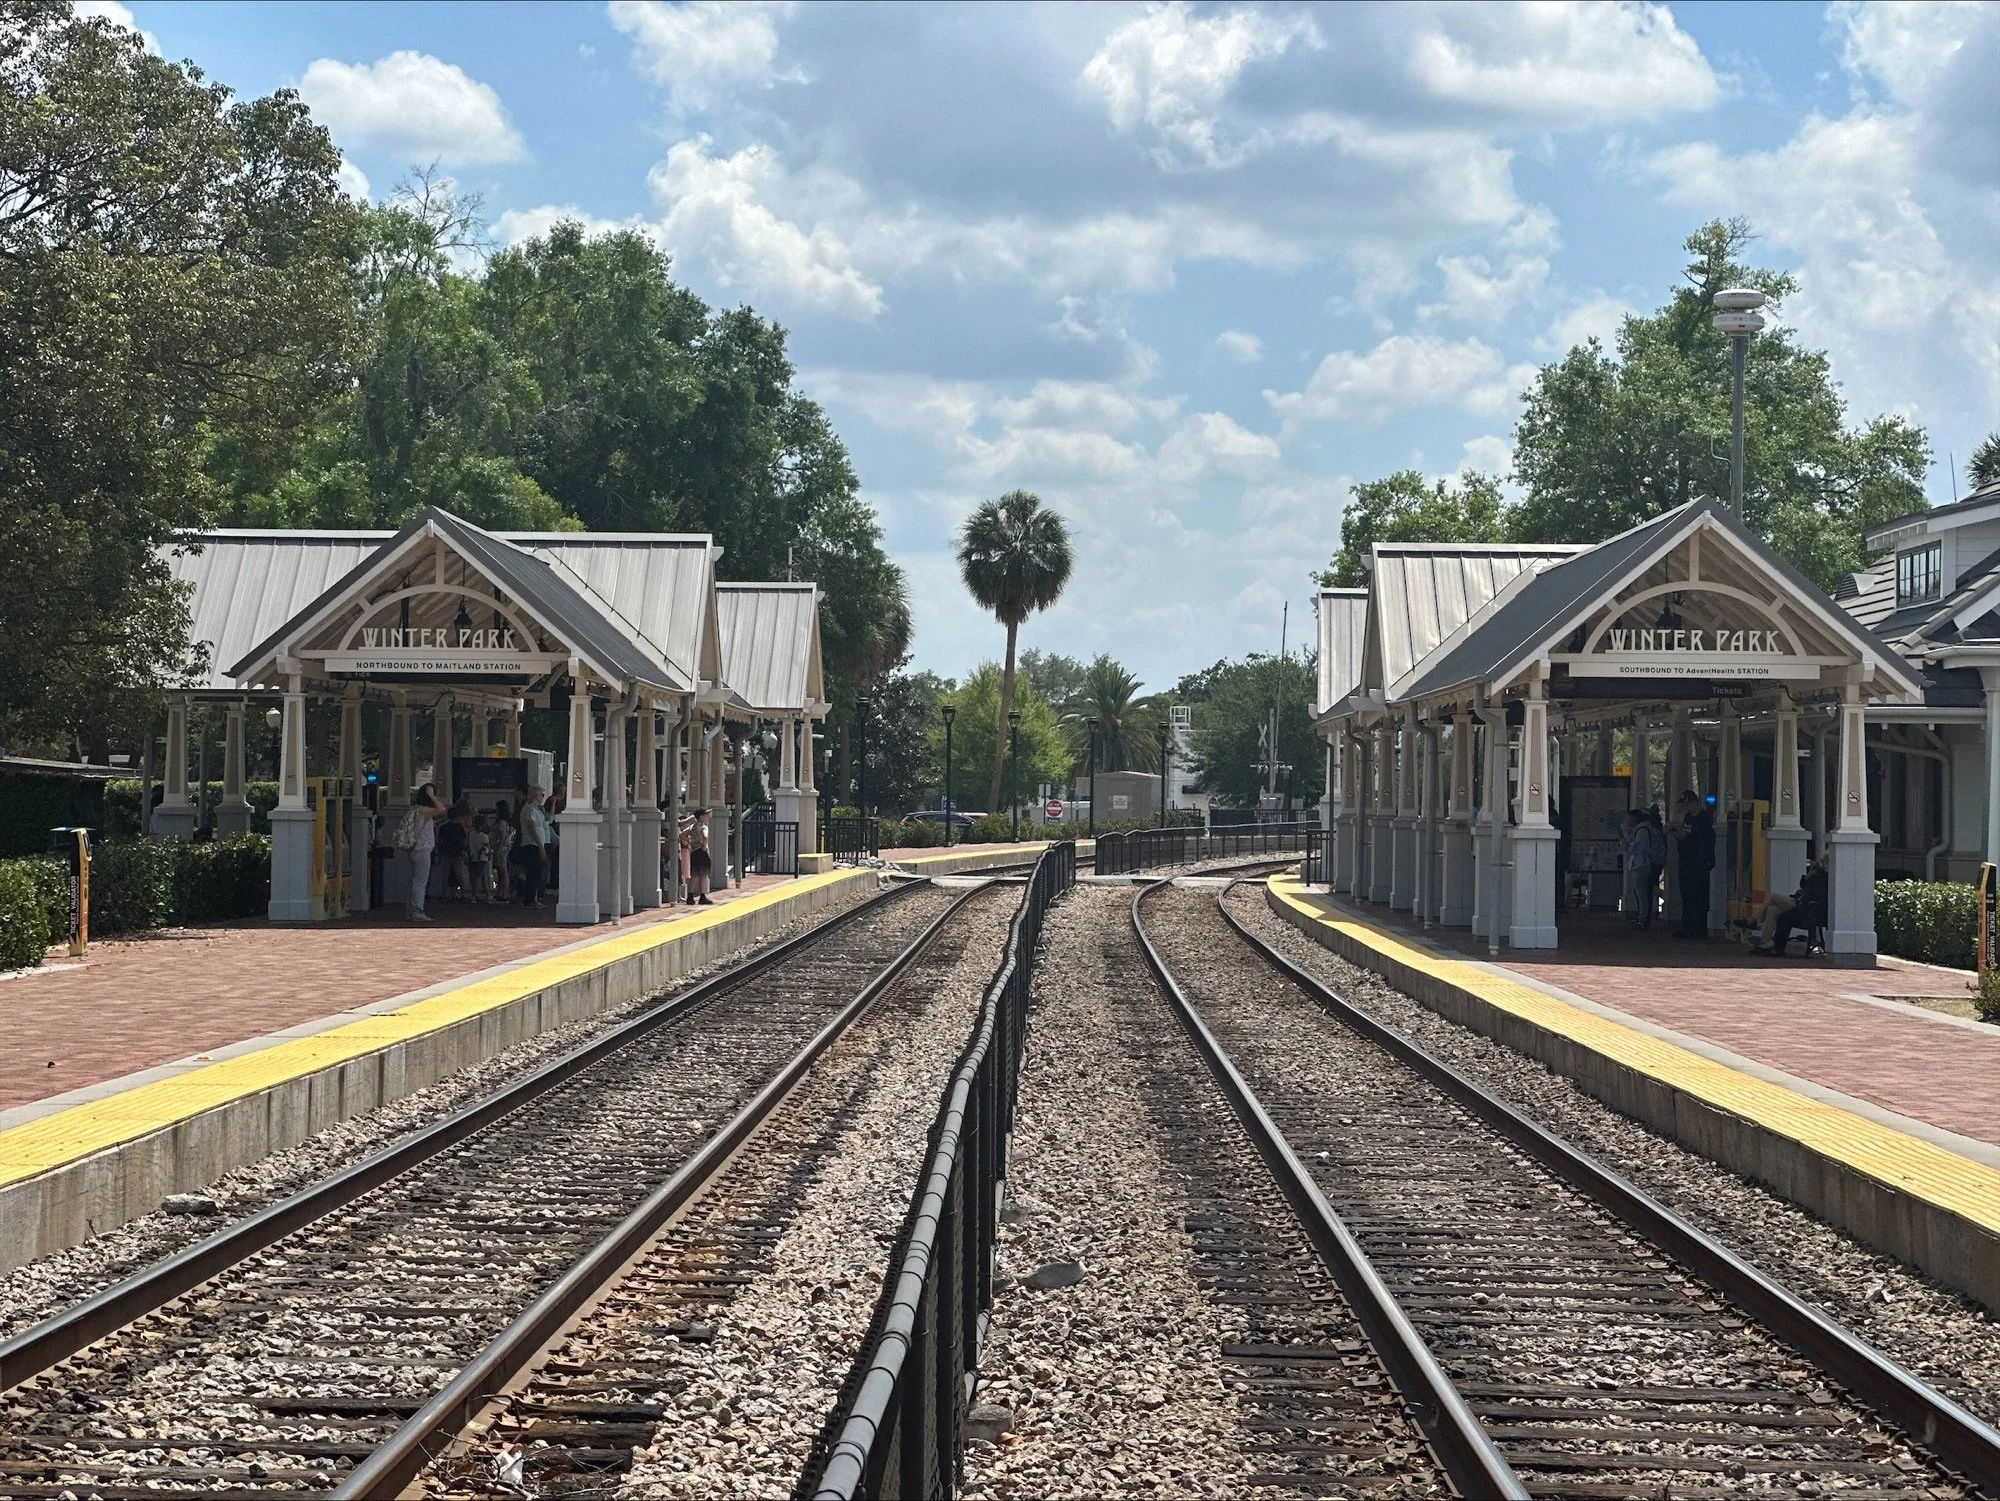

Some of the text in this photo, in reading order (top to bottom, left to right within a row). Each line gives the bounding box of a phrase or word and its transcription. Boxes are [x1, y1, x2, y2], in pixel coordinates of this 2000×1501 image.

[362, 628, 517, 649] WINTER PARK
[1609, 629, 1780, 652] WINTER PARK
